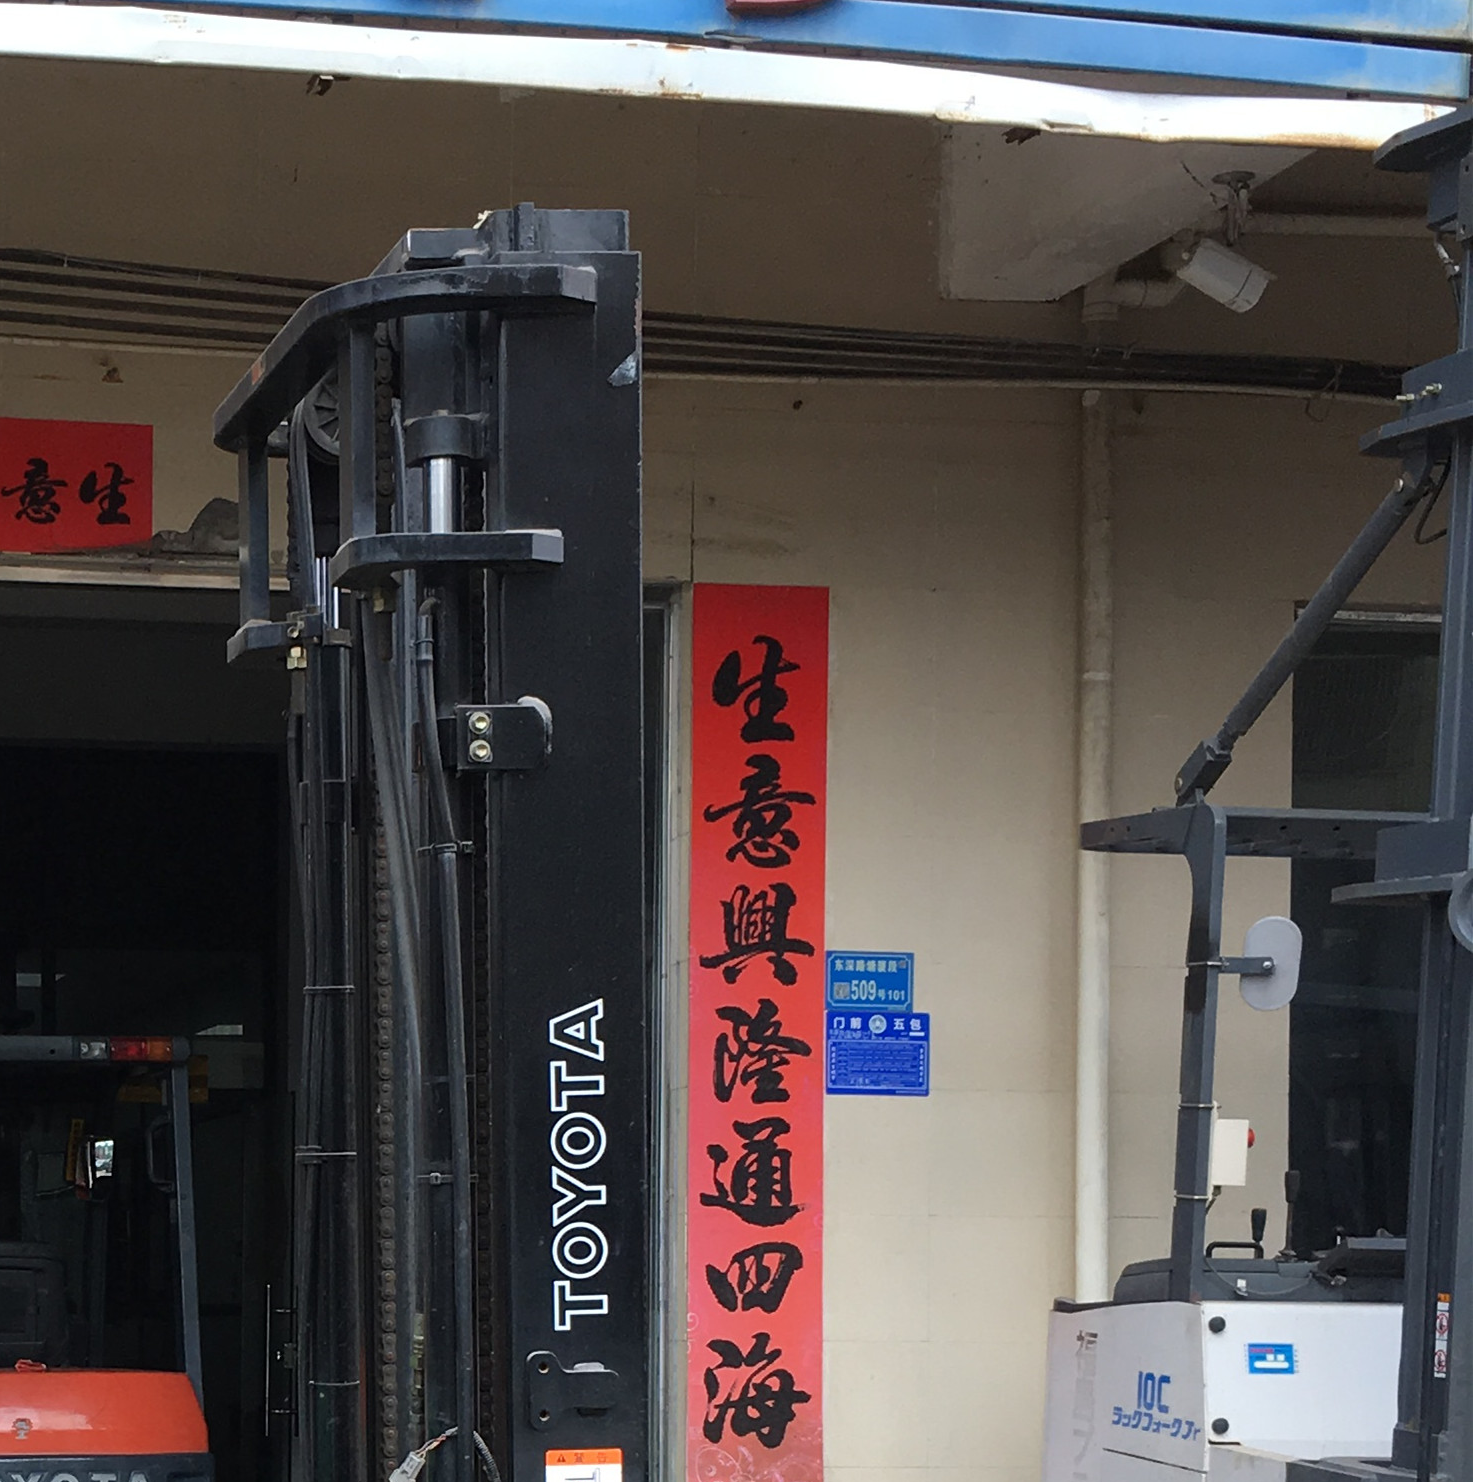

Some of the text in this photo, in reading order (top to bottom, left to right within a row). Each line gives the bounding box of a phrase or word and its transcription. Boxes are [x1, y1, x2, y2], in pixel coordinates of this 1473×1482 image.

[548, 998, 609, 1332] TOYOTA
[699, 635, 816, 1448] 生意興隆通四海
